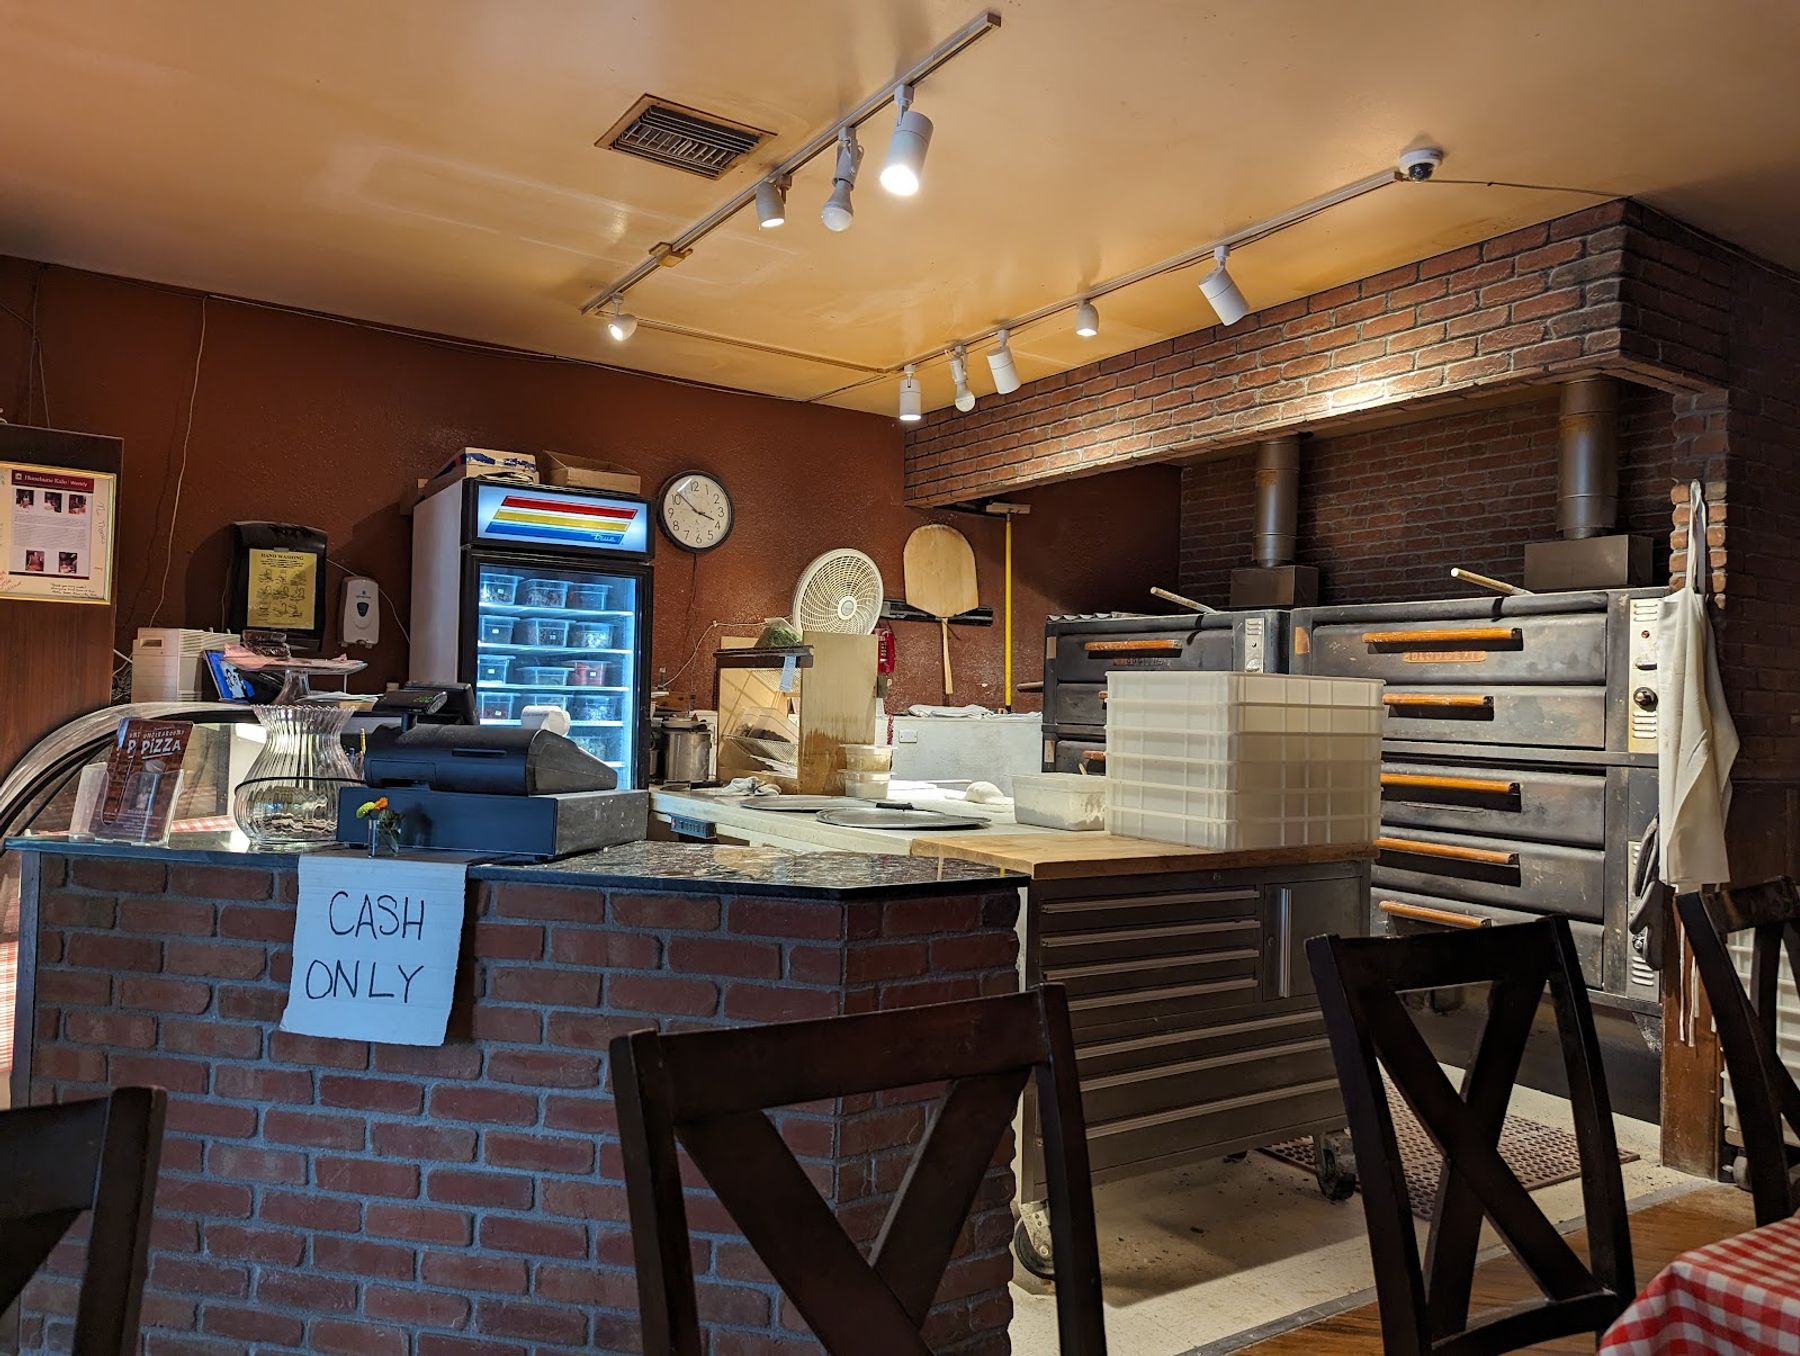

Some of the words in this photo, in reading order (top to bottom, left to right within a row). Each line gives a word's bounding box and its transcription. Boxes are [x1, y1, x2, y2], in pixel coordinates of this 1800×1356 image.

[690, 480, 700, 492] 12
[671, 494, 681, 505] 10
[713, 493, 720, 504] 2
[667, 507, 674, 519] 9
[718, 506, 725, 518] 3
[672, 520, 680, 531] 8
[714, 521, 721, 530] 4
[683, 530, 690, 540] 7
[695, 533, 703, 544] 6
[707, 530, 714, 541] 5
[329, 890, 425, 940] CASH
[305, 959, 425, 1003] ONLY
